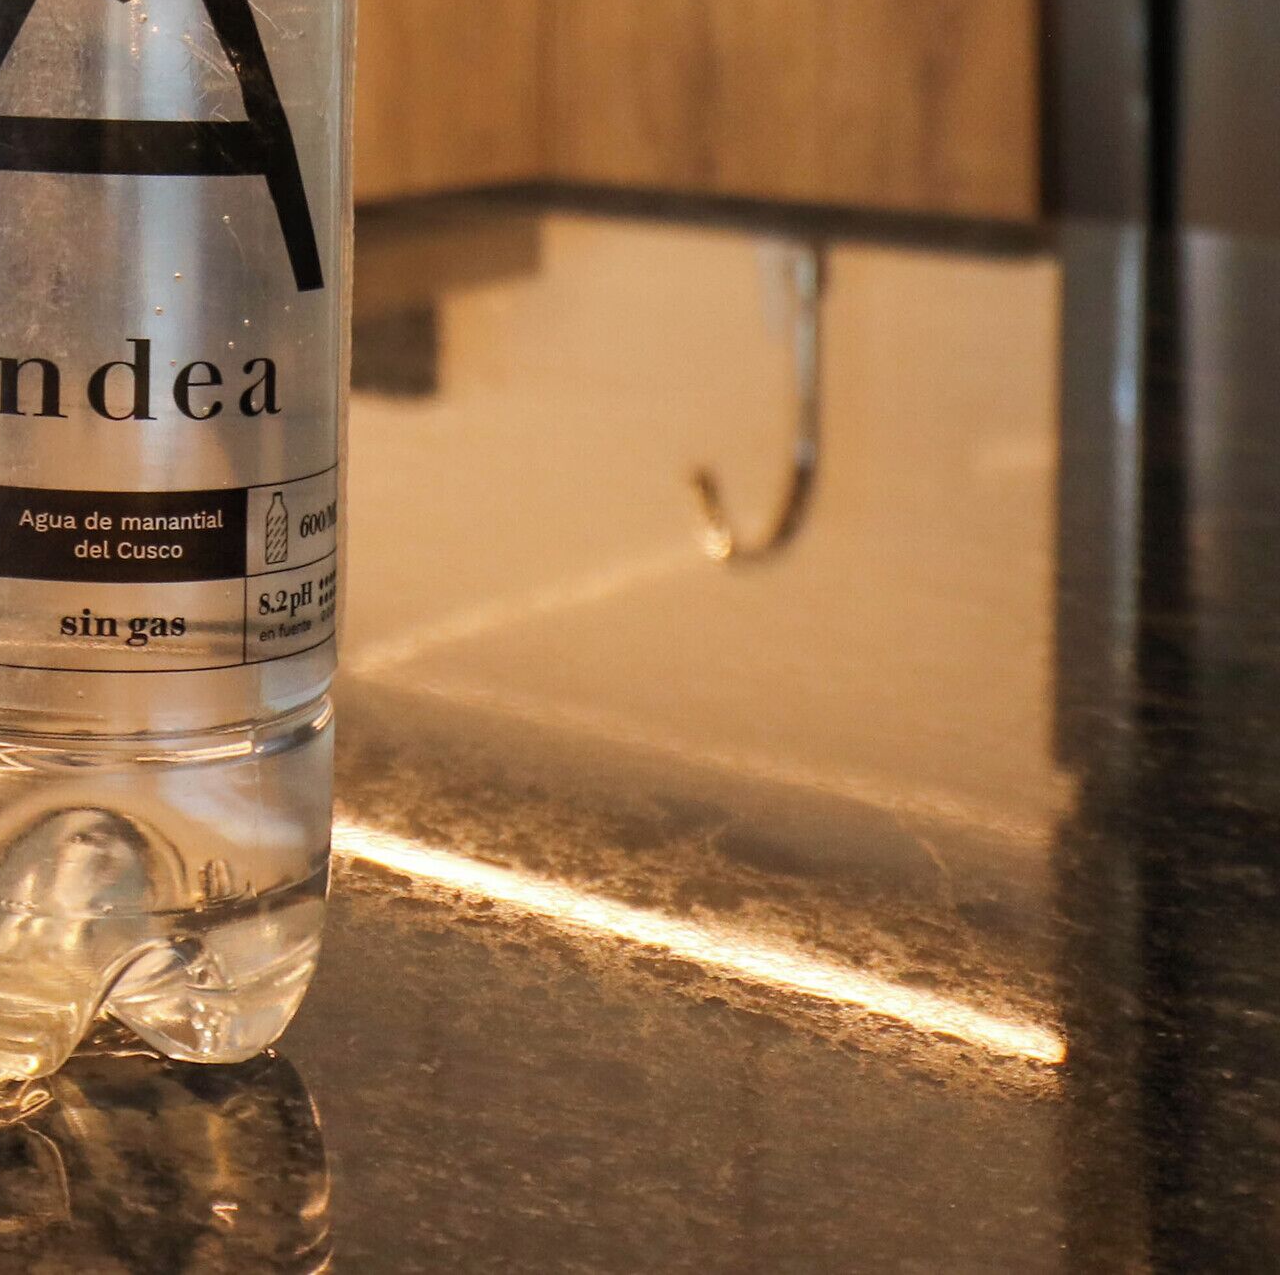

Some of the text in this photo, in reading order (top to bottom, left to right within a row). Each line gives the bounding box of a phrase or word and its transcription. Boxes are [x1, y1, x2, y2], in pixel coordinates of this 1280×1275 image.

[19, 509, 223, 532] Agua de manantial
[74, 540, 183, 560] del Cusco
[60, 608, 187, 647] sin gas
[259, 619, 312, 642] en fuente
